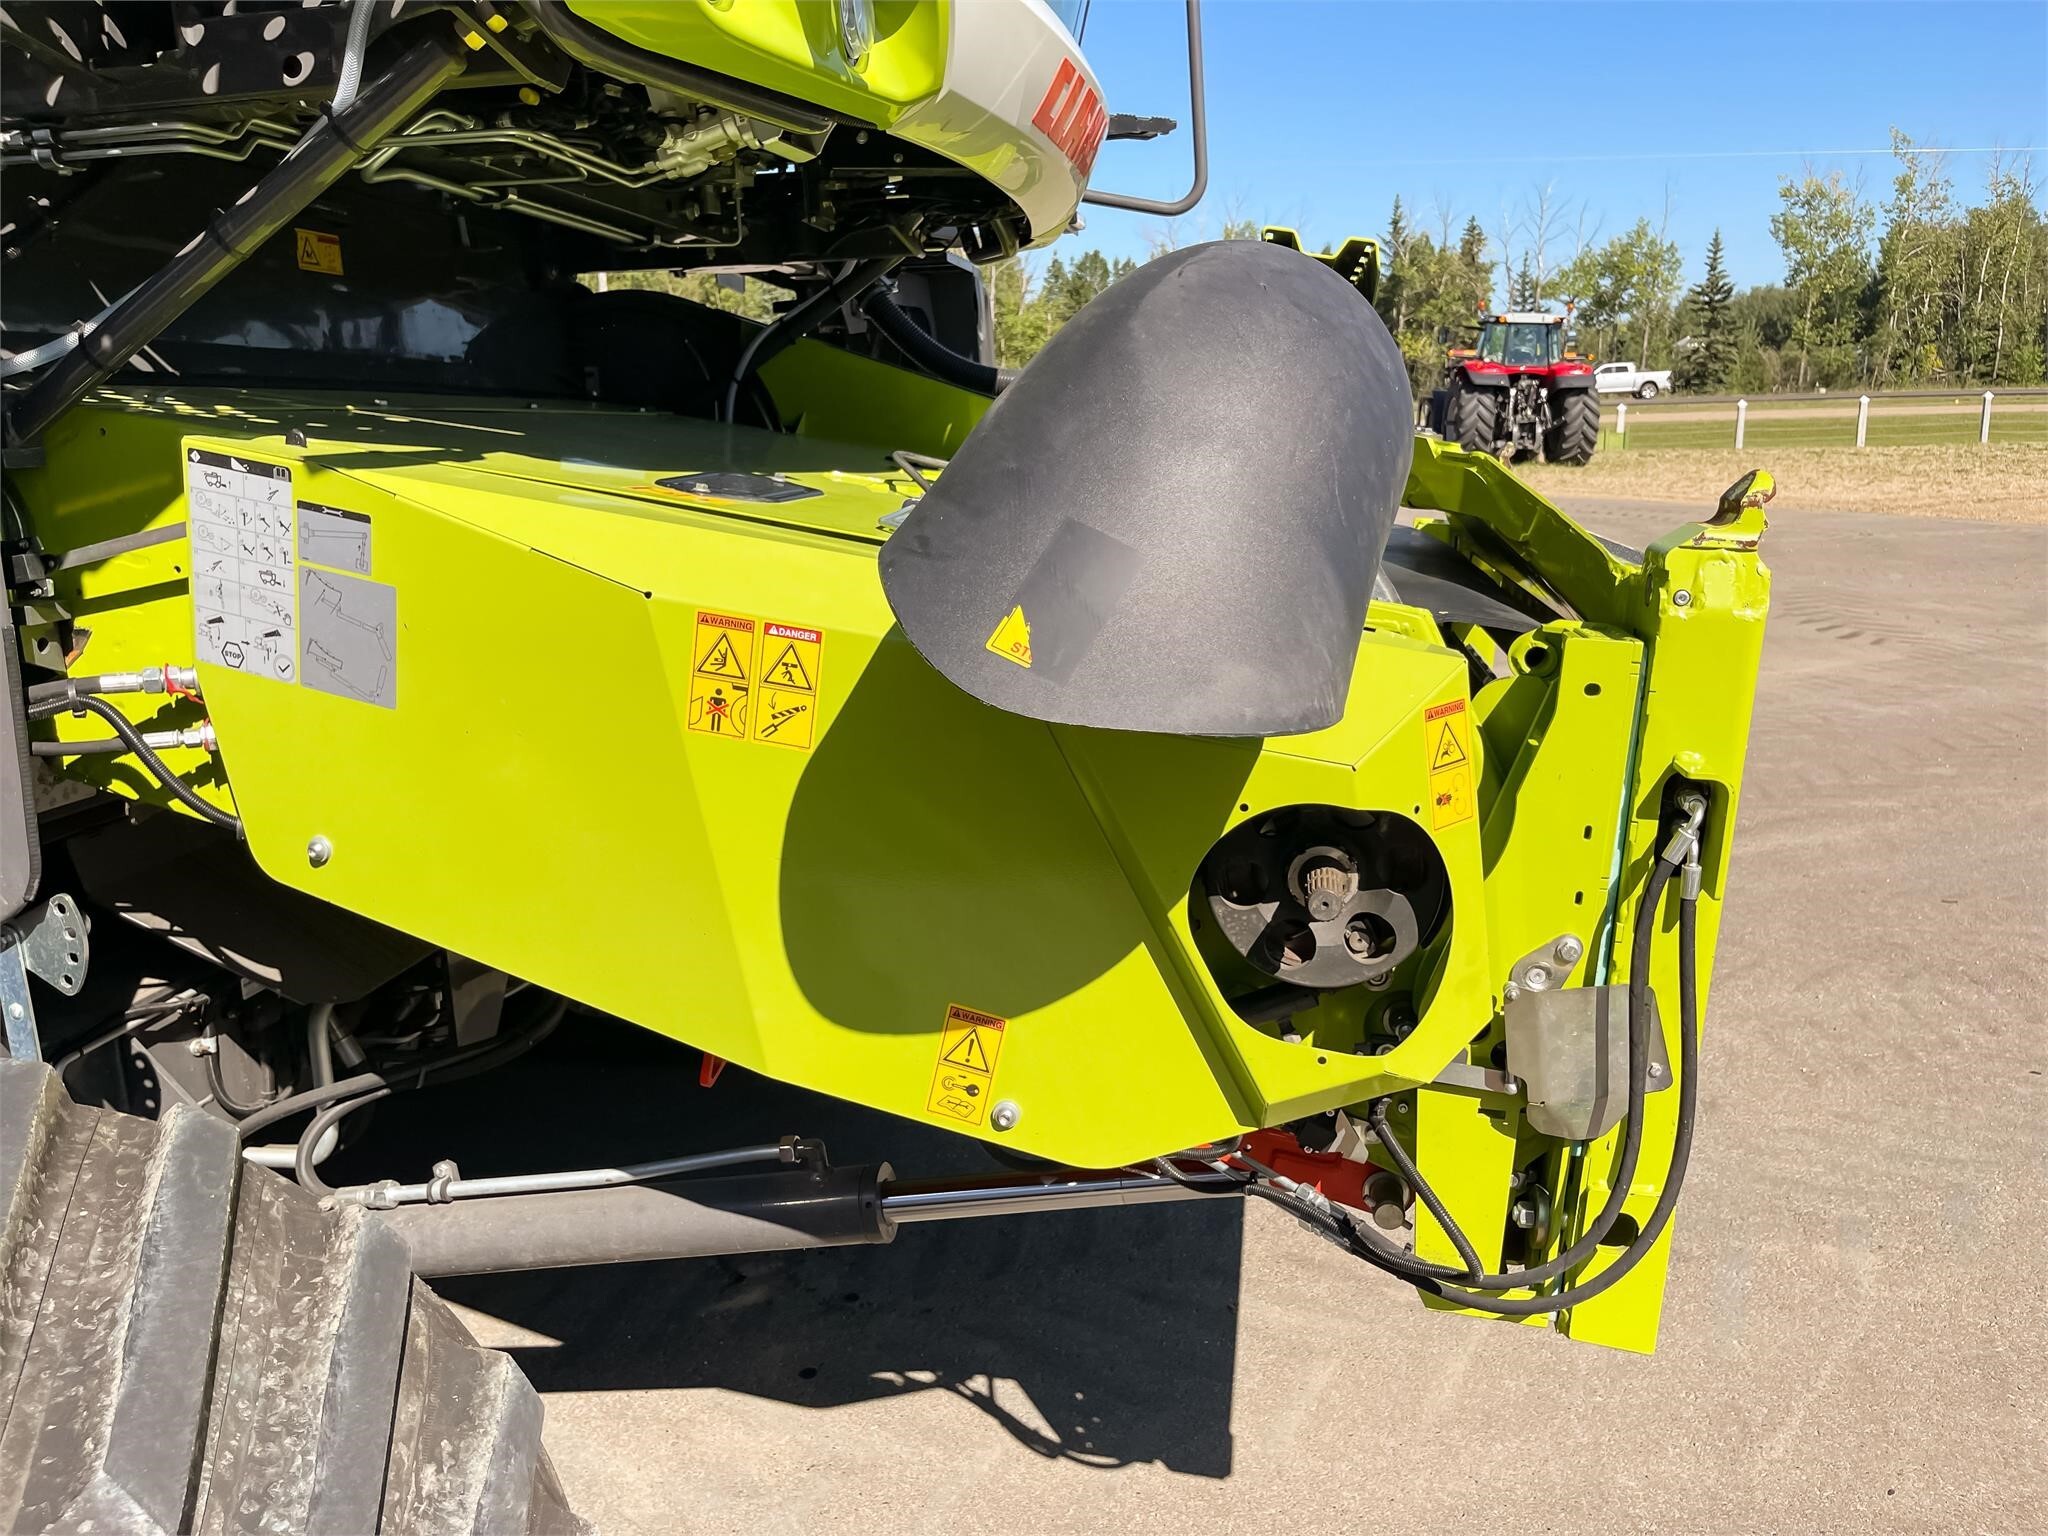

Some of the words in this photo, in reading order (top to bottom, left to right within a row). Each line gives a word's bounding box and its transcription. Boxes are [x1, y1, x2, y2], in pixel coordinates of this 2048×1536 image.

[710, 617, 753, 631] WARNING
[779, 627, 817, 641] DANGER
[225, 650, 241, 660] STOP
[1010, 642, 1032, 660] ST
[1434, 702, 1464, 716] WARNING
[962, 1012, 1002, 1030] WARNING
